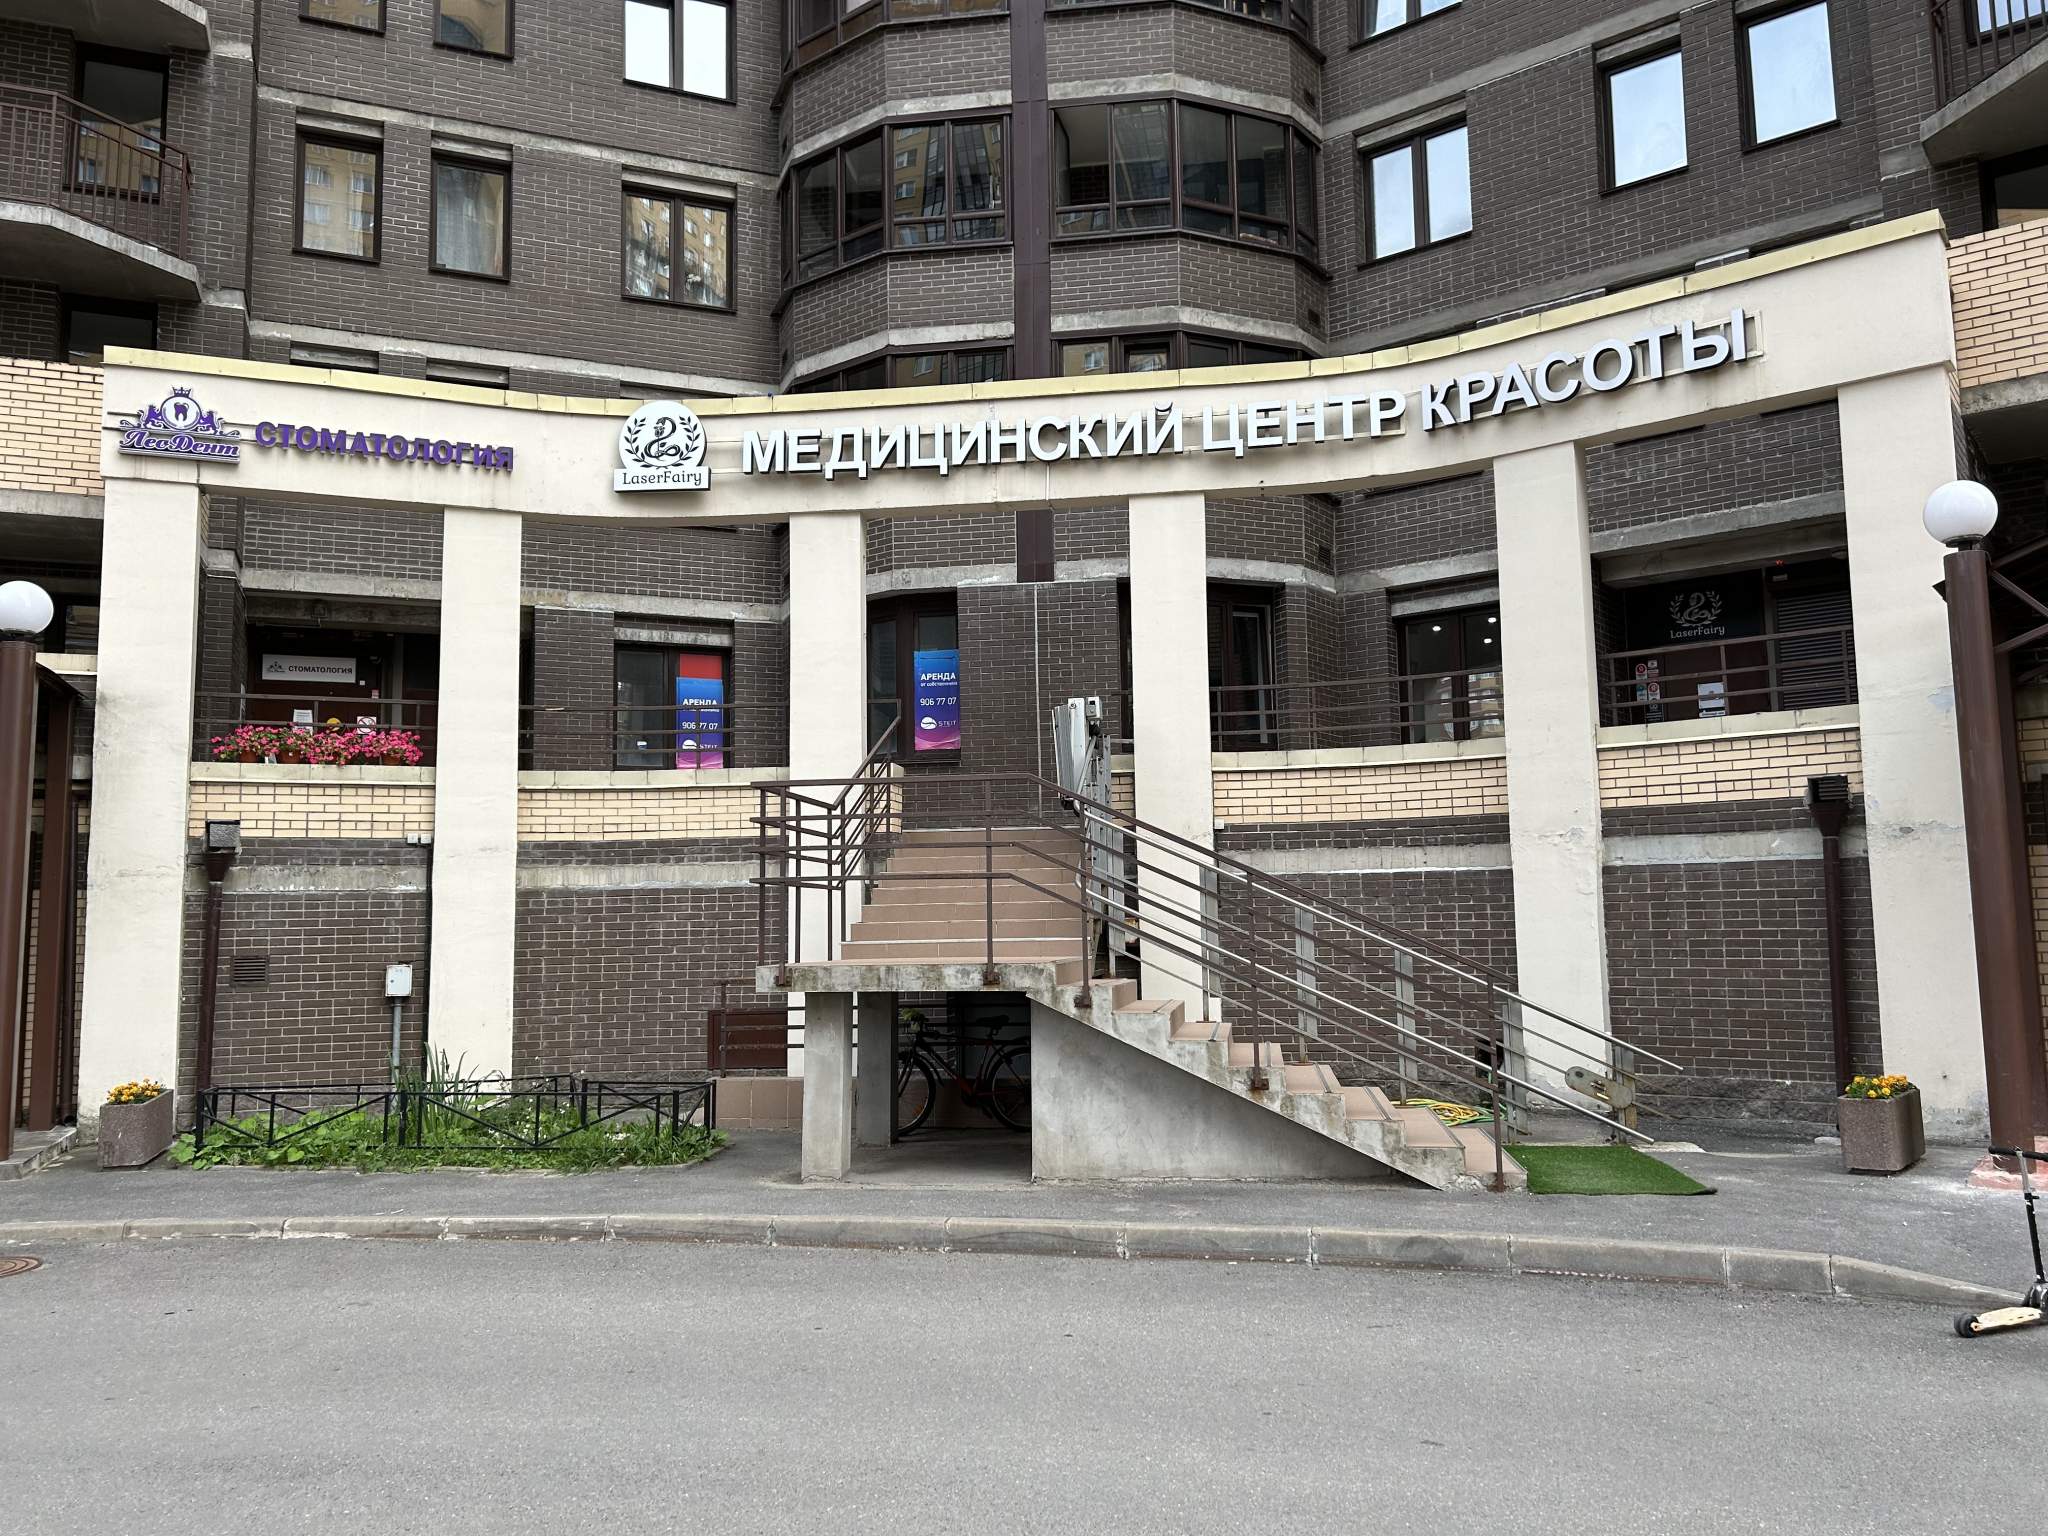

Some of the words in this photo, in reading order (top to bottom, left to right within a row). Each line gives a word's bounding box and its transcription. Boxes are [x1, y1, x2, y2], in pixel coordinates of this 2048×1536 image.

[742, 402, 1185, 480] МЕДИЦИНСКИЙ
[1202, 390, 1407, 459] ЦЕНТР
[1420, 307, 1747, 433] КРАСОТЫ
[120, 428, 240, 458] ЛеоДент
[254, 421, 514, 472] СТОМАТОЛОГИЯ
[622, 468, 702, 489] LaserFairy
[1670, 624, 1725, 639] LaserFairy
[288, 664, 353, 675] СТОМАТОЛОГИЯ
[921, 673, 956, 681] АРЕНДА
[947, 697, 957, 705] 07
